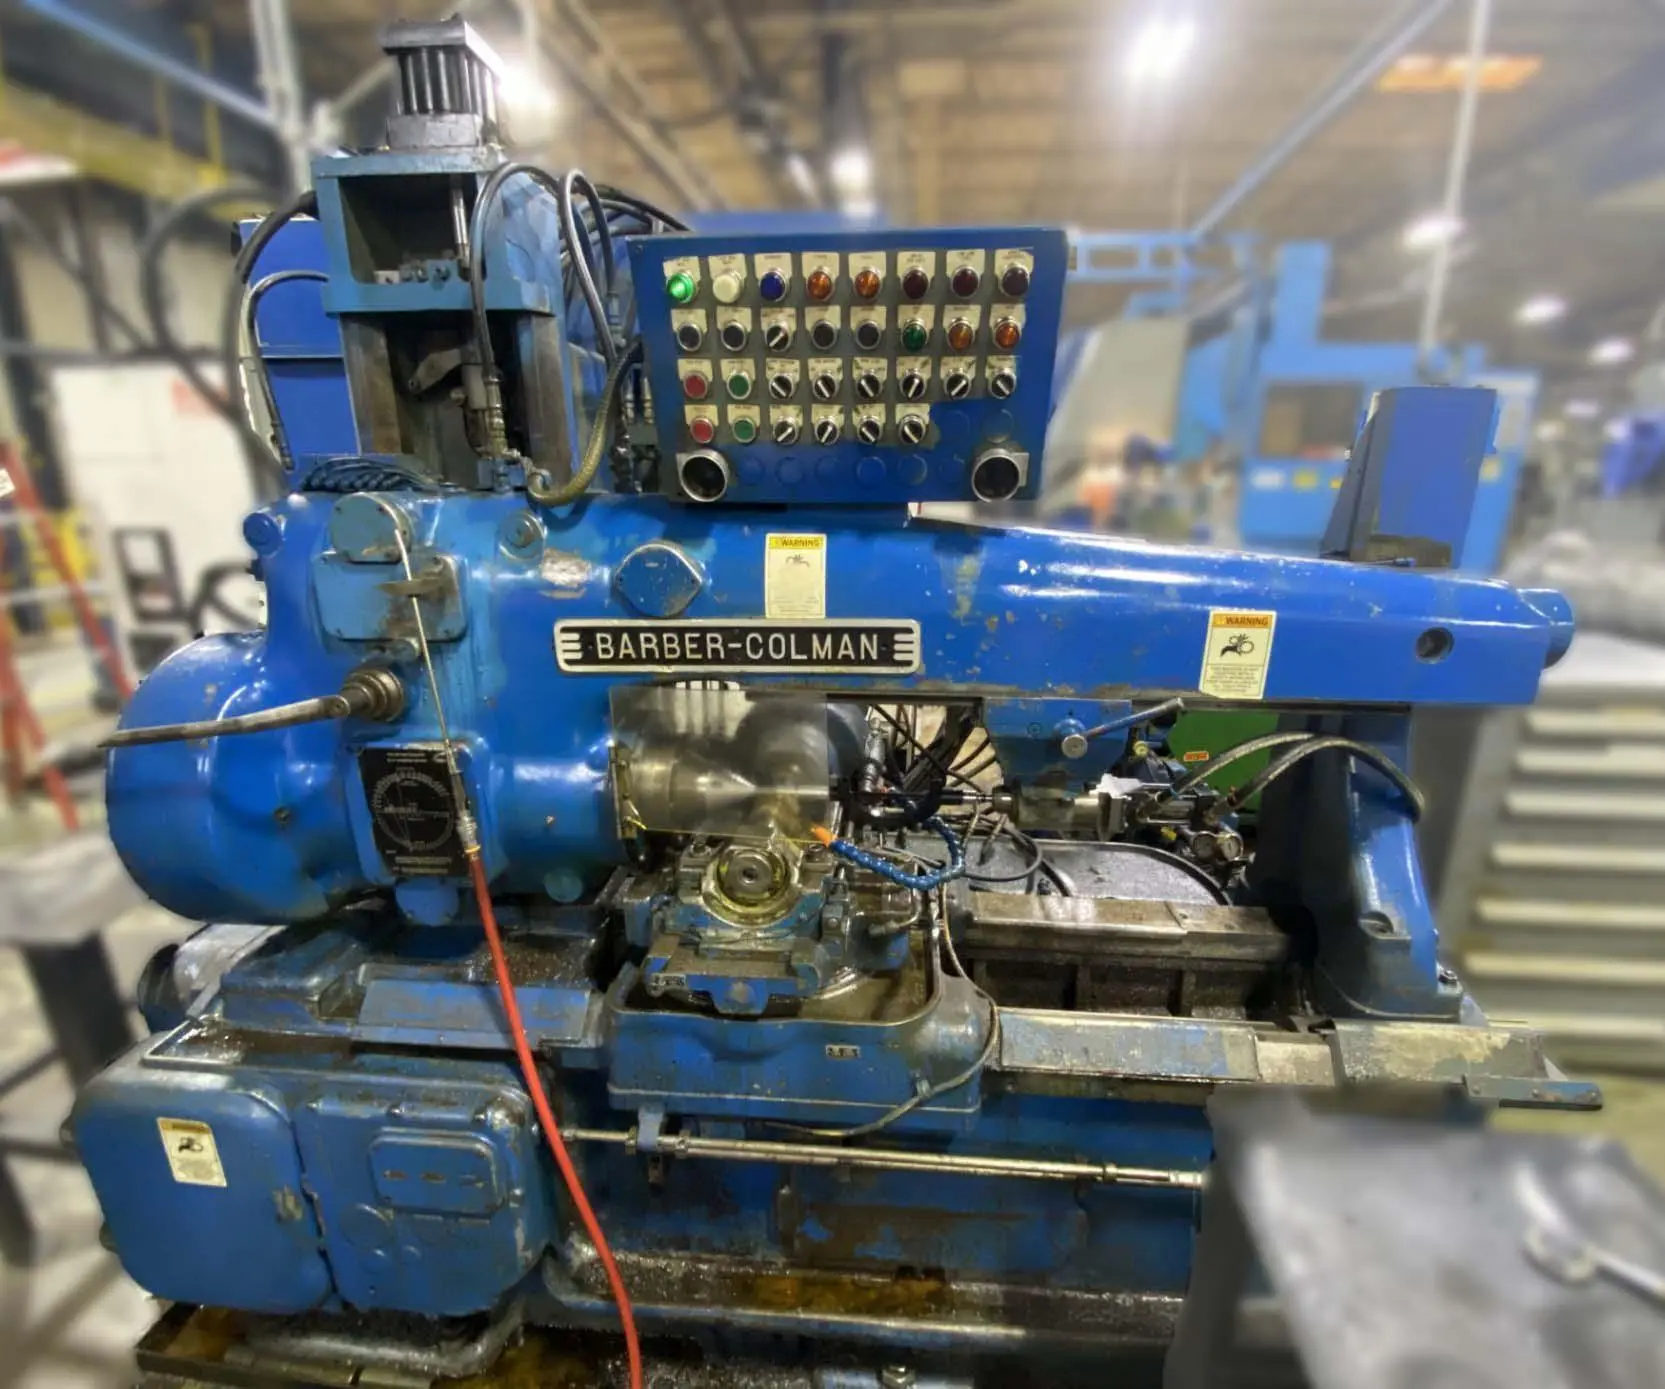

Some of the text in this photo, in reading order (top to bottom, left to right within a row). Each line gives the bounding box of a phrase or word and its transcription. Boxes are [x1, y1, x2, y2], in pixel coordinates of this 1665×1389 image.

[781, 538, 820, 548] WARNING
[1226, 616, 1269, 626] WARNING
[595, 632, 879, 660] BARBER-COLMAN
